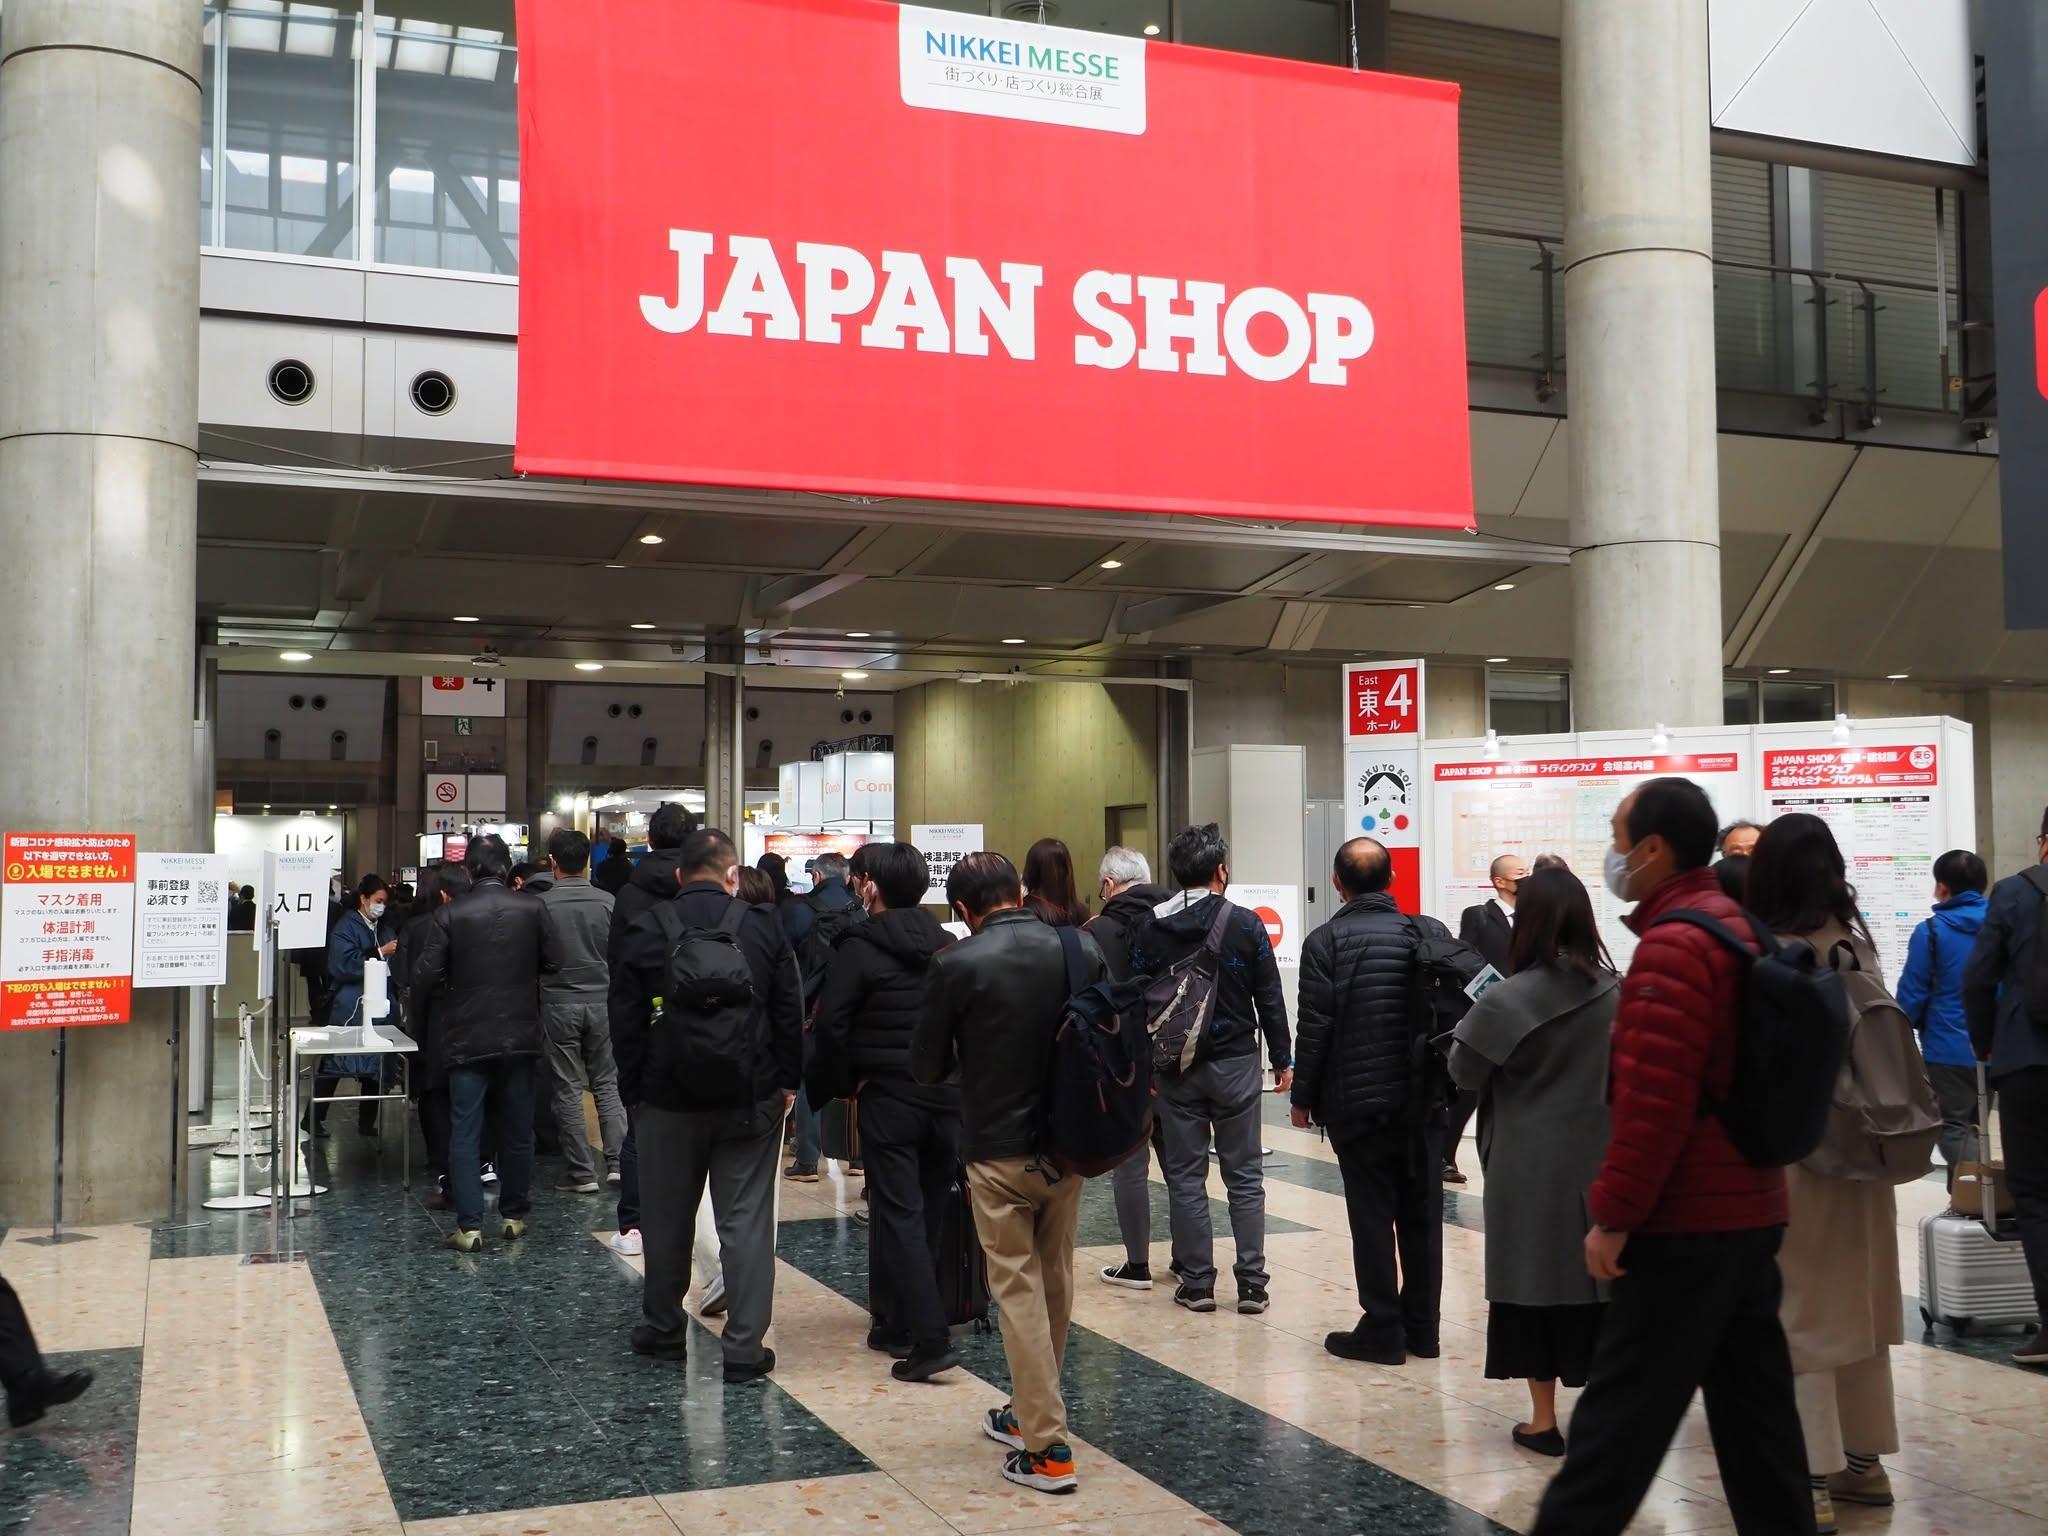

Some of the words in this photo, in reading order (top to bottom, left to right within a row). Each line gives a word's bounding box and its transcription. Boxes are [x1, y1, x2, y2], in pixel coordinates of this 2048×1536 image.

[926, 30, 1020, 66] NIKKEI
[1028, 45, 1120, 80] MESSE
[639, 228, 1043, 361] JAPAN
[1073, 269, 1375, 386] SHOP
[1359, 676, 1378, 686] East
[1358, 689, 1380, 718] 東
[1384, 674, 1413, 717] 4
[1367, 719, 1401, 732] ホール
[1771, 755, 1805, 765] JAPAN
[1358, 764, 1379, 788] FUKU
[1382, 764, 1395, 772] YO
[1397, 768, 1412, 787] KOI
[1440, 768, 1467, 776] JAPAN
[1468, 767, 1493, 776] SHOP
[10, 836, 131, 848] 新型コロナ感染拡大防止のため
[26, 864, 128, 879] 入場できません！
[147, 879, 190, 891] 事前登録
[37, 893, 103, 907] マスク着用
[146, 895, 189, 906] 必須です
[274, 893, 312, 913] 入口
[42, 920, 95, 934] 体温計測
[42, 948, 95, 963] 手指消毒
